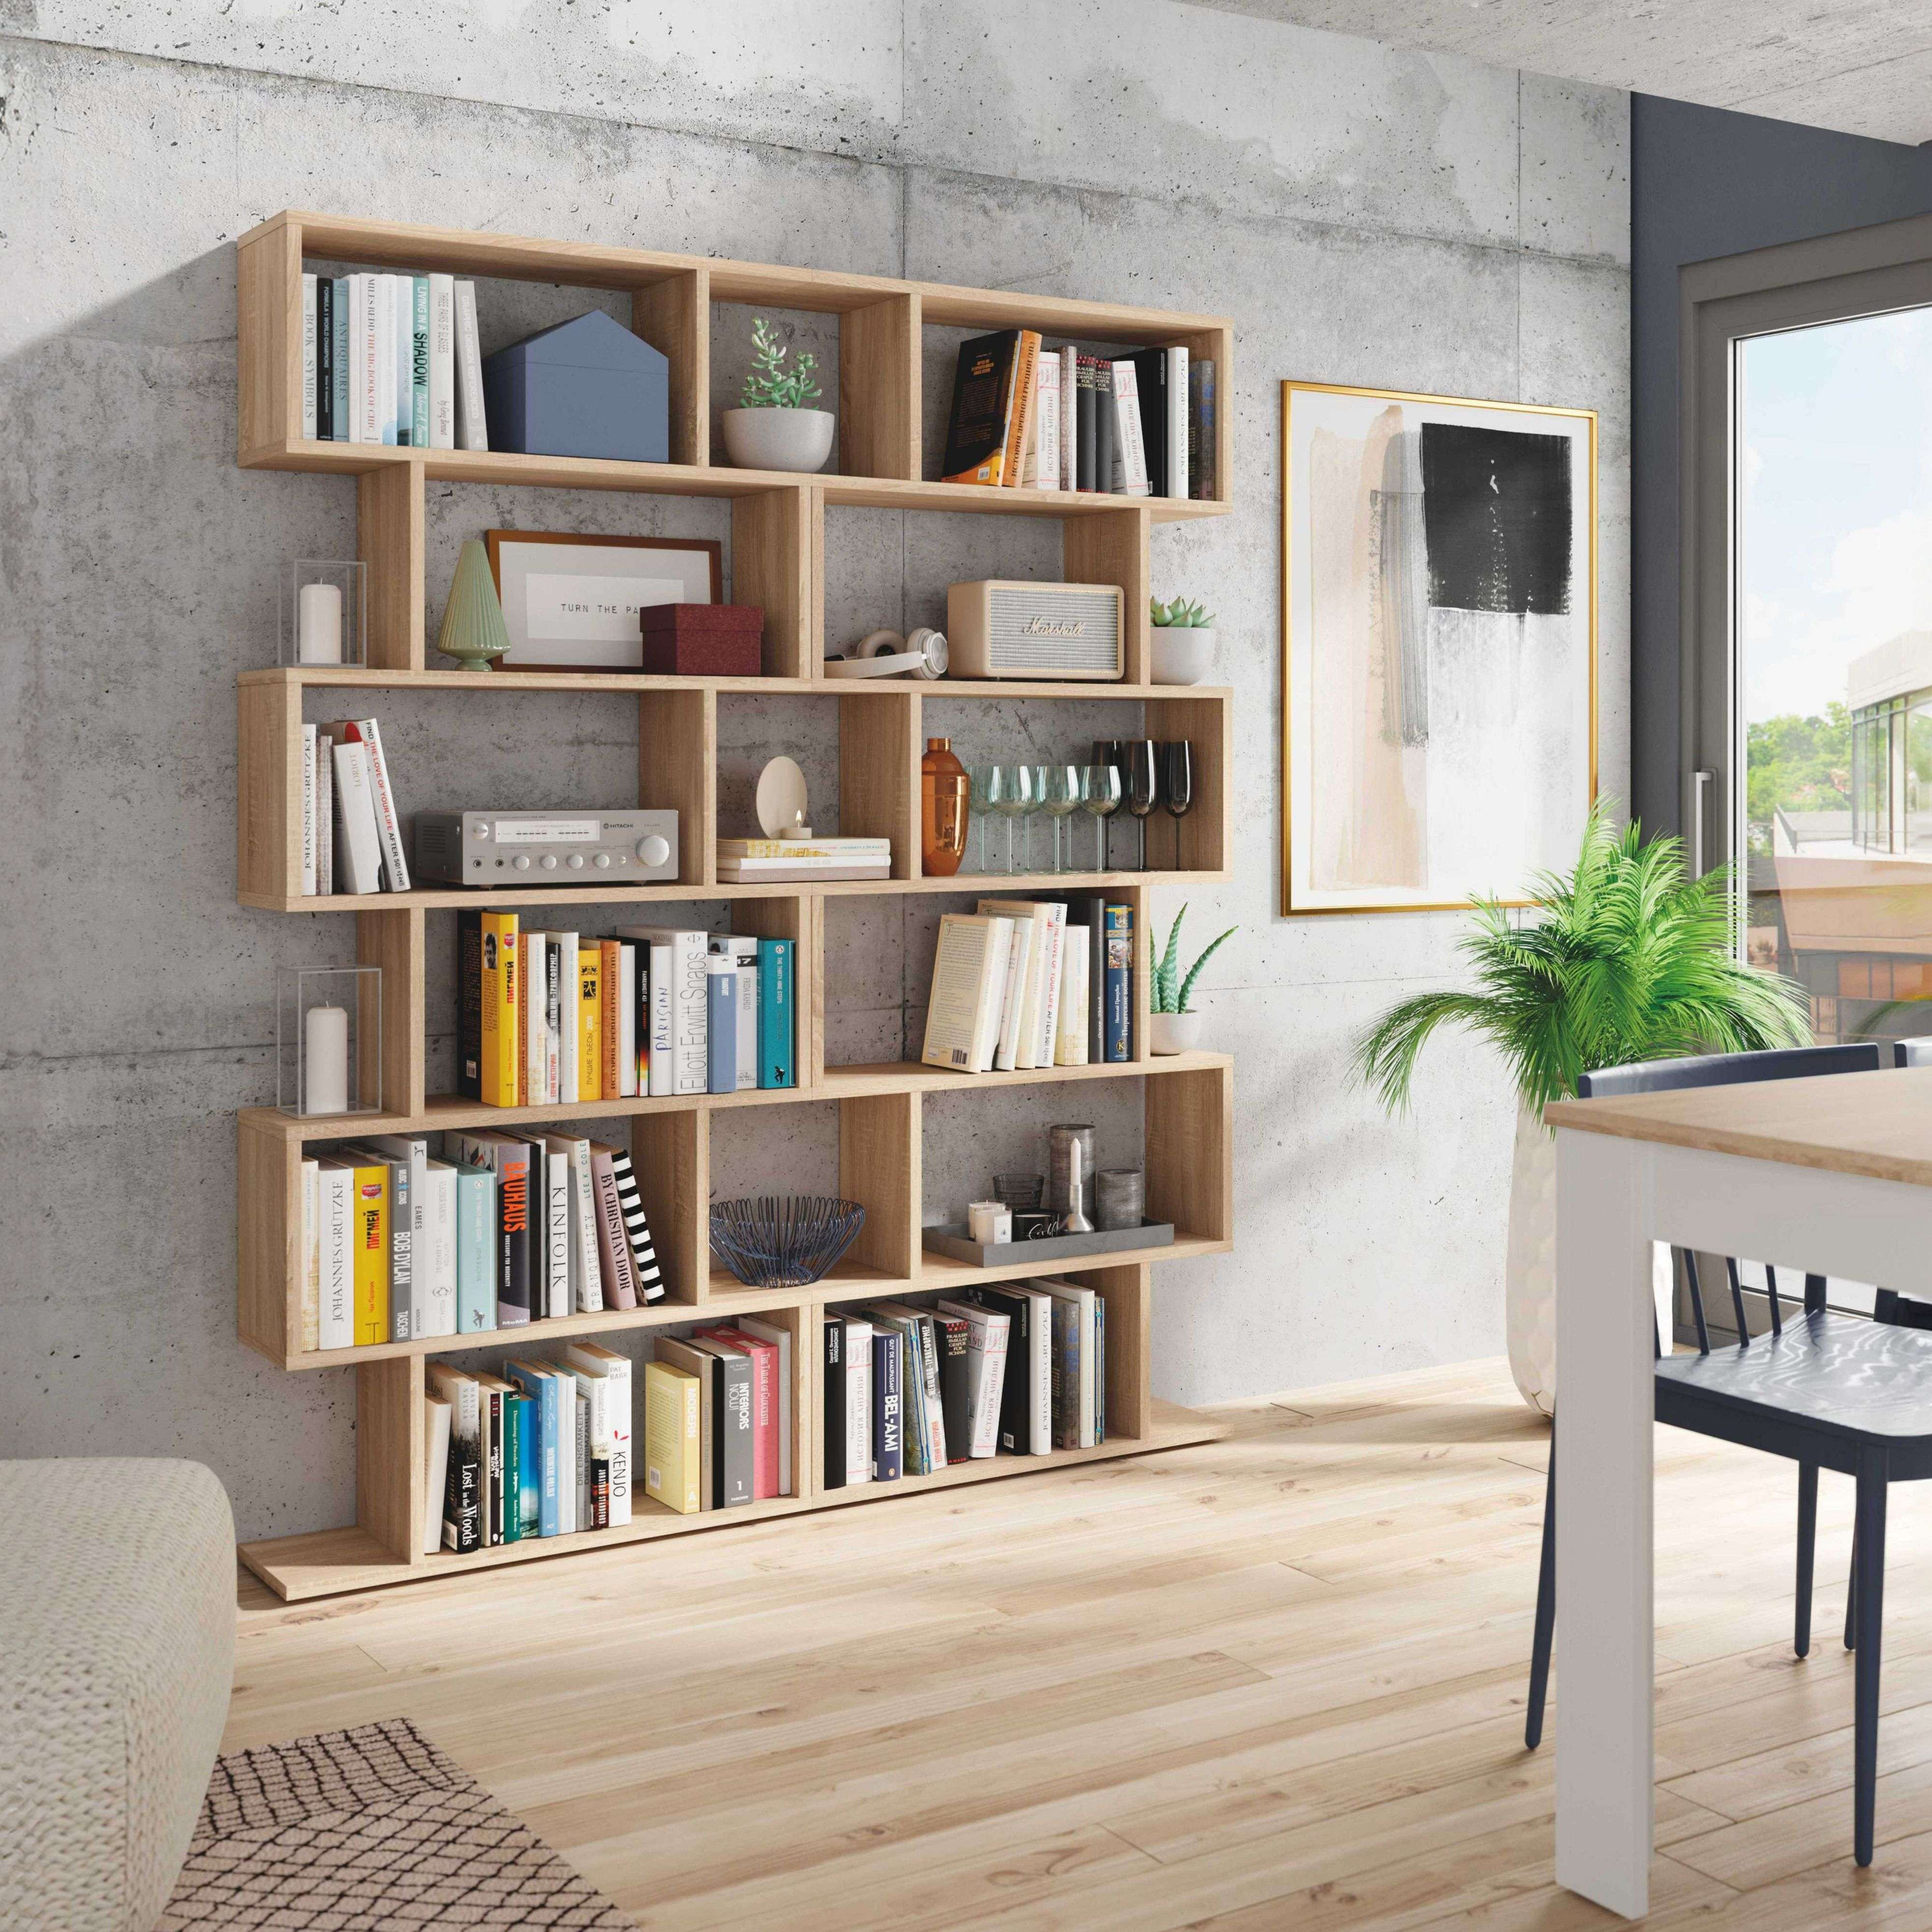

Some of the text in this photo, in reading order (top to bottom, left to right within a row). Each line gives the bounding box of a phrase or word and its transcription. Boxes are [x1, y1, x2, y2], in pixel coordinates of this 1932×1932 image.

[417, 286, 426, 313] LIVING
[417, 314, 426, 323] IN
[438, 293, 449, 307] THREE
[438, 308, 449, 323] PAIRS
[305, 313, 315, 346] BOOK
[438, 332, 449, 354] GLASSES
[339, 320, 348, 400] ANTIQUAIRES
[414, 332, 427, 386] SHADOW
[462, 296, 480, 419] GRAPHIC DESIGN REFERENCED
[305, 359, 315, 419] SYMBOLS
[368, 395, 375, 408] OF
[1011, 360, 1032, 477] ИСТОРИЯ ДРЕВНЕЙ ГРЕЦИИ
[1132, 435, 1140, 478] ИСТОРИЯ
[561, 603, 617, 614] TURN THE
[1023, 615, 1087, 637] Marshall
[347, 753, 361, 787] LORIOT
[373, 755, 383, 778] LOVE
[378, 779, 385, 791] OF
[380, 789, 390, 814] YOUR
[385, 812, 394, 831] LIFE
[388, 832, 398, 858] AFTER
[653, 987, 672, 1051] PARISIAN
[681, 952, 707, 1089] Elliott Erwitt Snaps
[398, 1169, 407, 1205] MUSIC ICONS
[503, 1162, 527, 1233] BAUHAUS
[363, 1209, 380, 1250] ПИГМЕЙ
[553, 1187, 566, 1288] KINFOLK
[600, 1174, 631, 1291] BY CHRISTIAN DIOR
[333, 1180, 343, 1322] JOHANNES GRÜTZKE
[394, 1231, 411, 1285] BOB DYLAN
[585, 1215, 600, 1306] TRANQUILITY
[397, 1310, 408, 1338] TASCHEN
[761, 1352, 770, 1364] THE
[761, 1364, 770, 1384] TAILOR
[922, 1325, 936, 1396] ЖЕНЩИНА-ТРАНСФОРМЕР
[597, 1383, 606, 1436] Thousand Leagues
[687, 1388, 696, 1438] MODERN
[729, 1384, 739, 1411] NOW!
[739, 1382, 749, 1430] INTERIORS
[761, 1392, 770, 1426] GLOUCESTER
[985, 1392, 994, 1438] ИСТОРИЯ
[884, 1394, 898, 1452] BEL-AMI
[931, 1420, 940, 1448] НЕСТЕРИНА
[462, 1463, 477, 1491] Lost
[612, 1451, 626, 1497] KENJO
[737, 1480, 742, 1491] 1
[598, 1469, 607, 1524] JONATHAN STANDFORD
[462, 1505, 477, 1546] Woods
